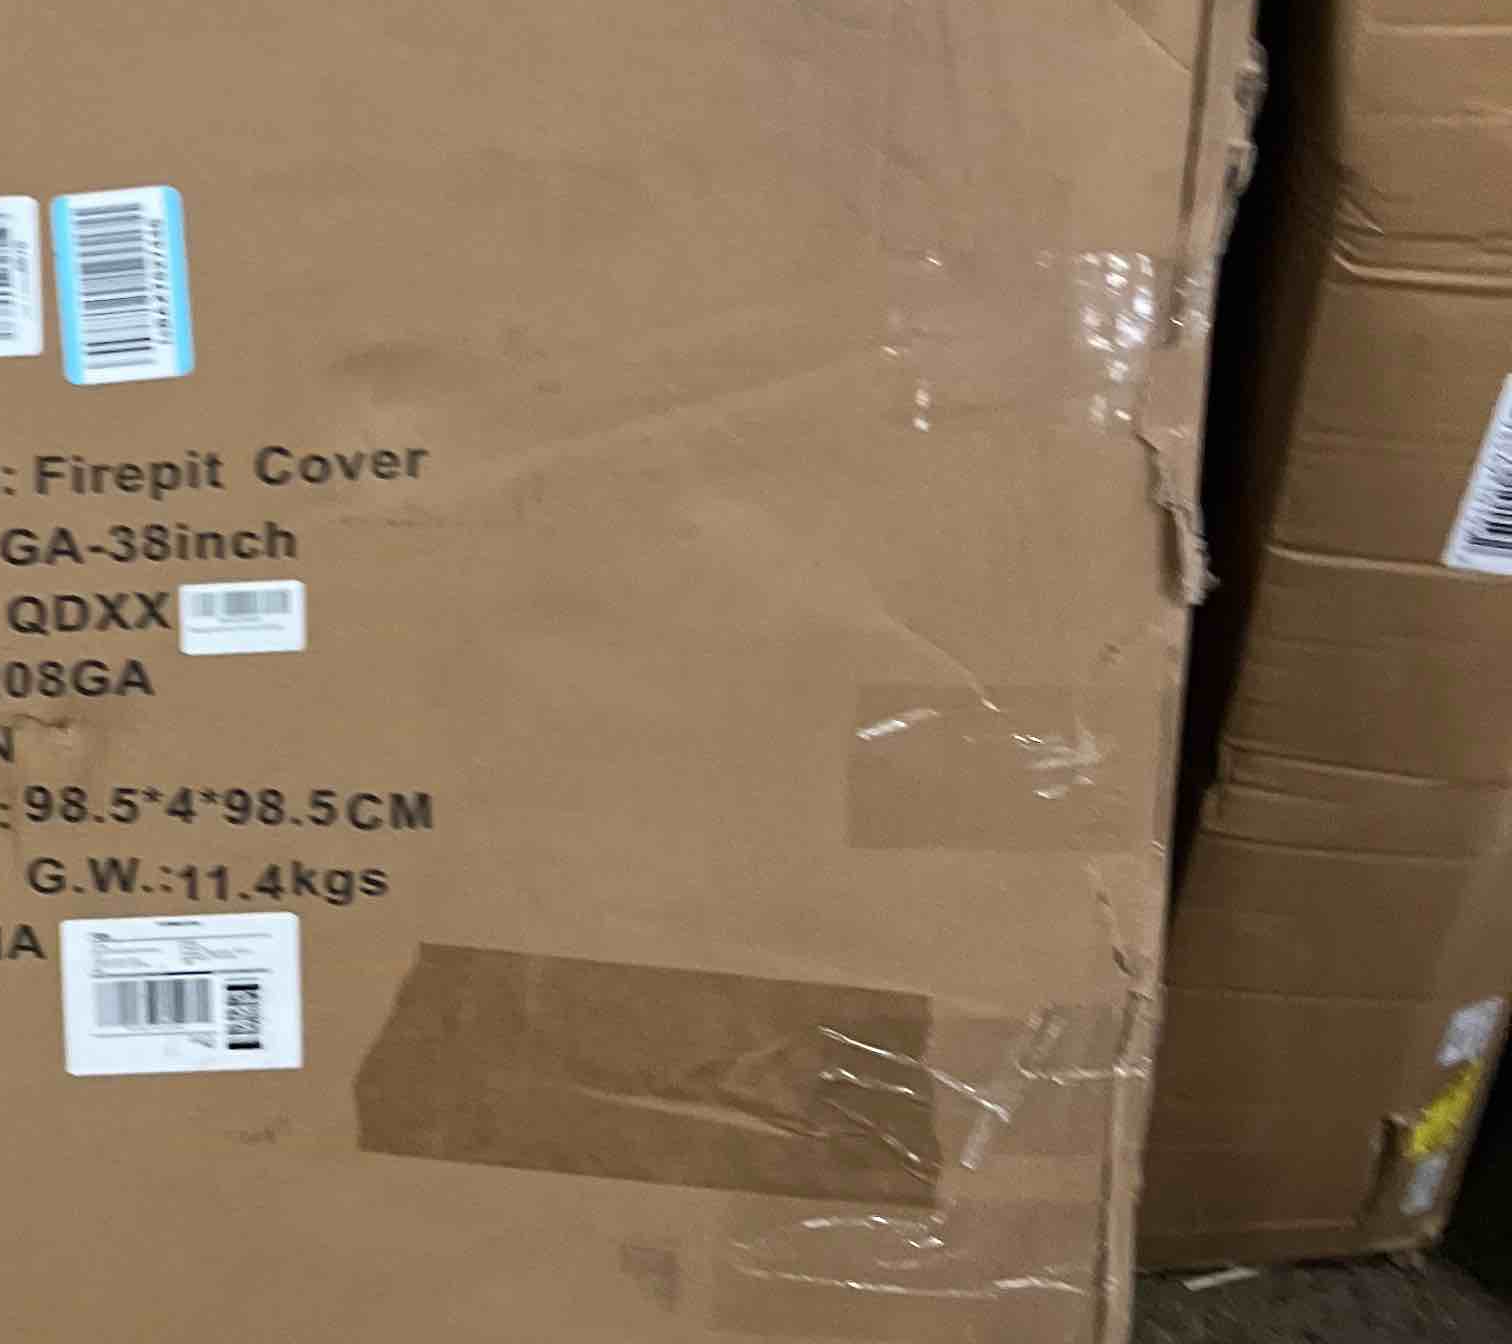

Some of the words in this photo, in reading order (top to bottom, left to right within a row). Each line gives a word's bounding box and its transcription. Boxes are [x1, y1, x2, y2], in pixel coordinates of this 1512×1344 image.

[33, 450, 226, 502] Firepit
[252, 444, 430, 488] Cover
[6, 591, 173, 637] QDXX
